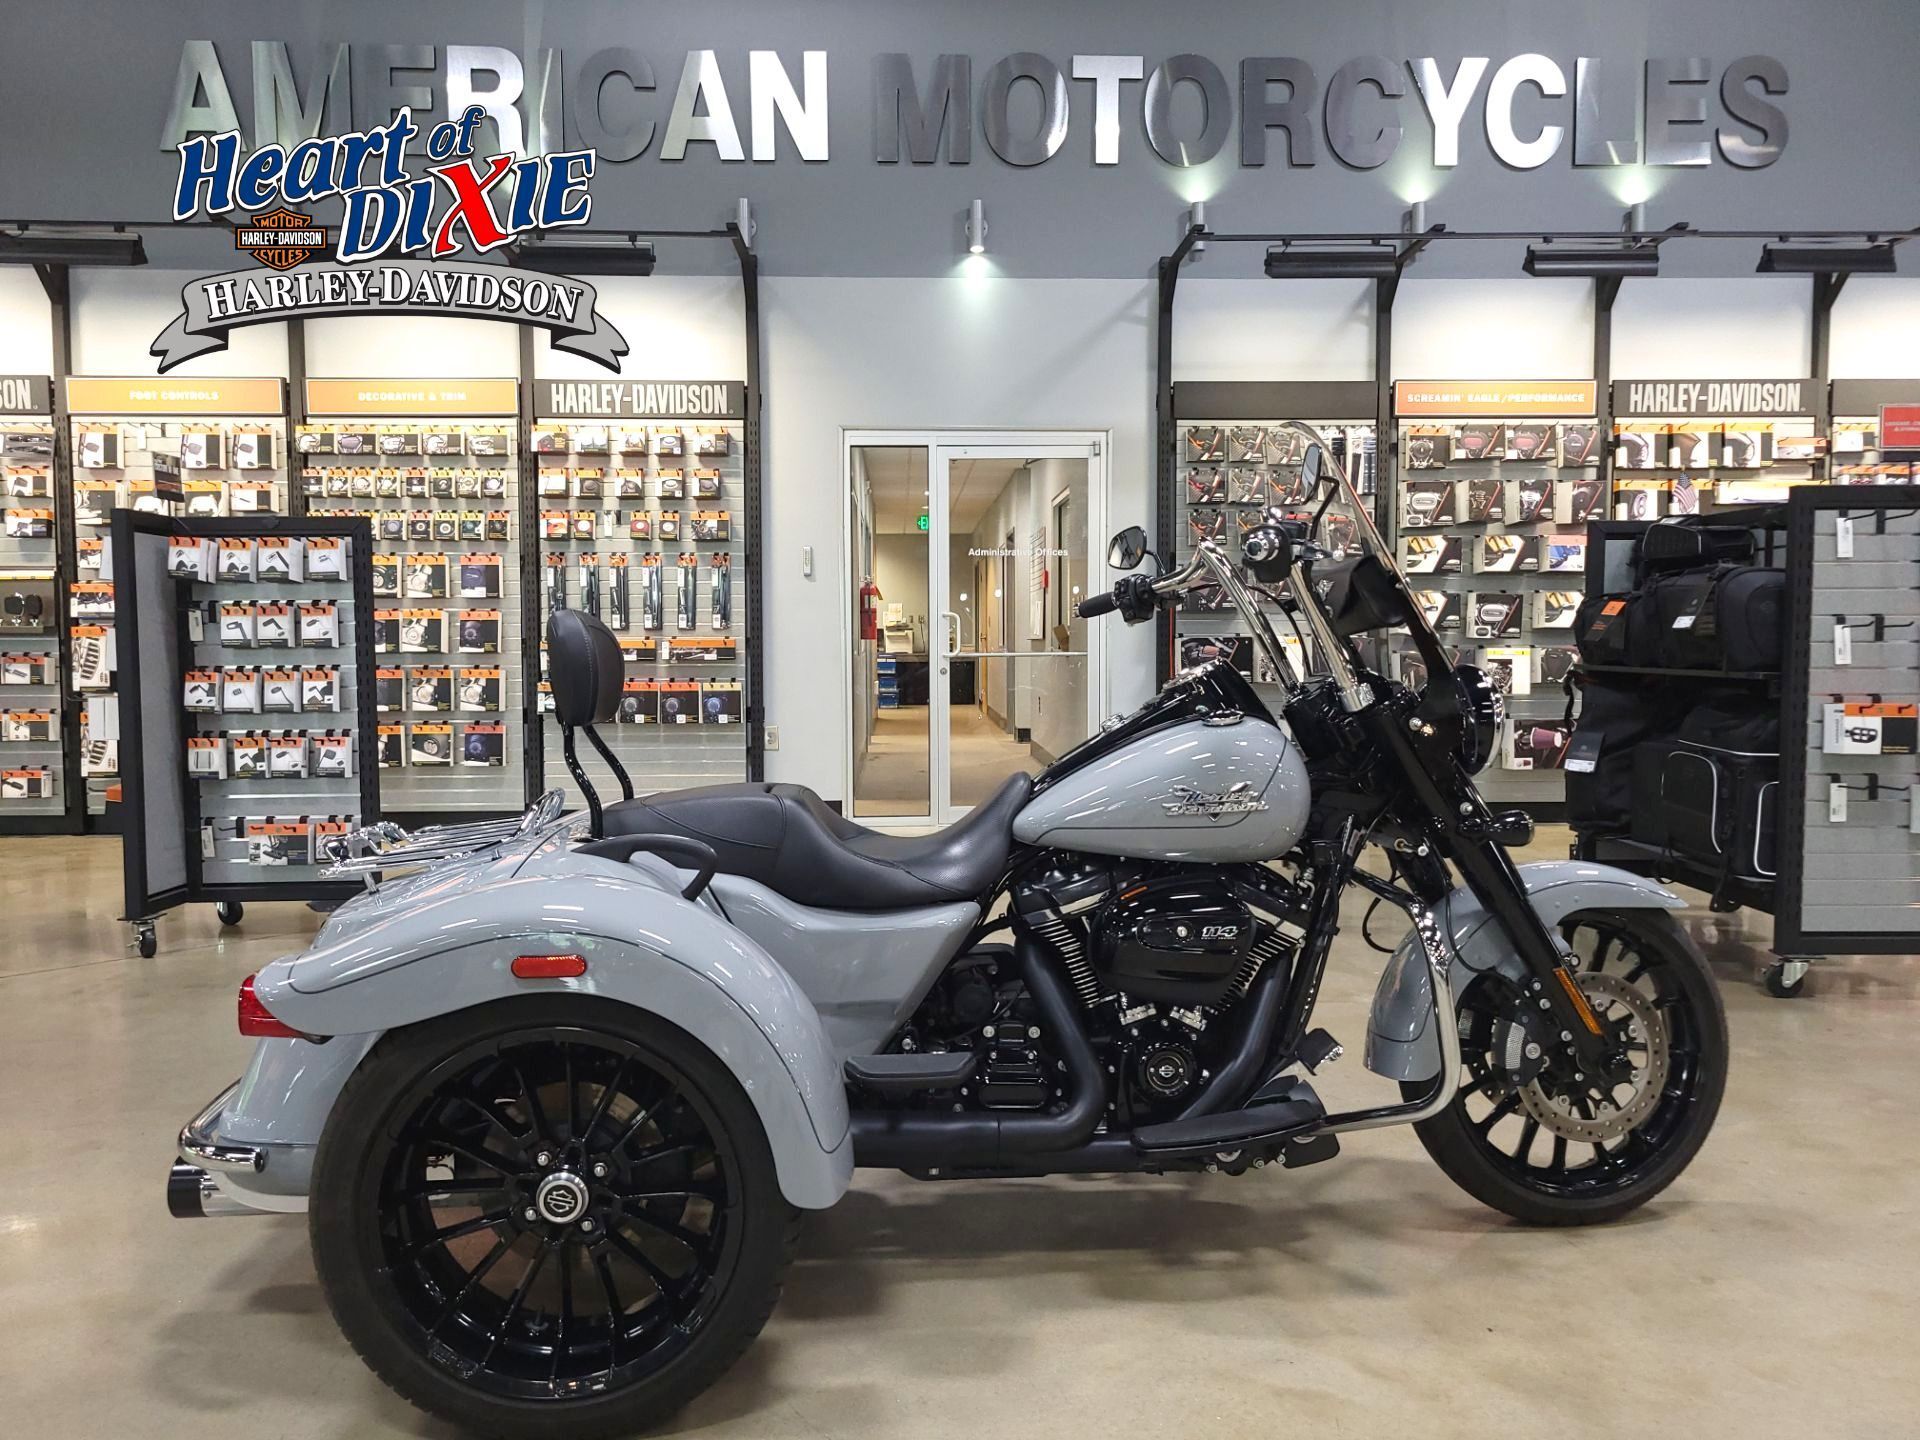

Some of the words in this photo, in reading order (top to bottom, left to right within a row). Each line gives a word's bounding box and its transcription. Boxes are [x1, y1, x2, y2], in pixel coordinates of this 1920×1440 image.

[161, 39, 829, 163] AMERICAN
[875, 51, 1790, 168] MOTORCYCLES
[129, 390, 158, 401] FOOT
[161, 390, 219, 401] CONTROLS
[358, 391, 425, 401] DECORATIVE
[428, 391, 437, 401] &
[440, 391, 467, 401] TRIM
[551, 383, 728, 415] HARLEY-DAVIDSON
[1629, 383, 1801, 413] HARLEY-DAVIDSON
[1202, 926, 1238, 937] 114
